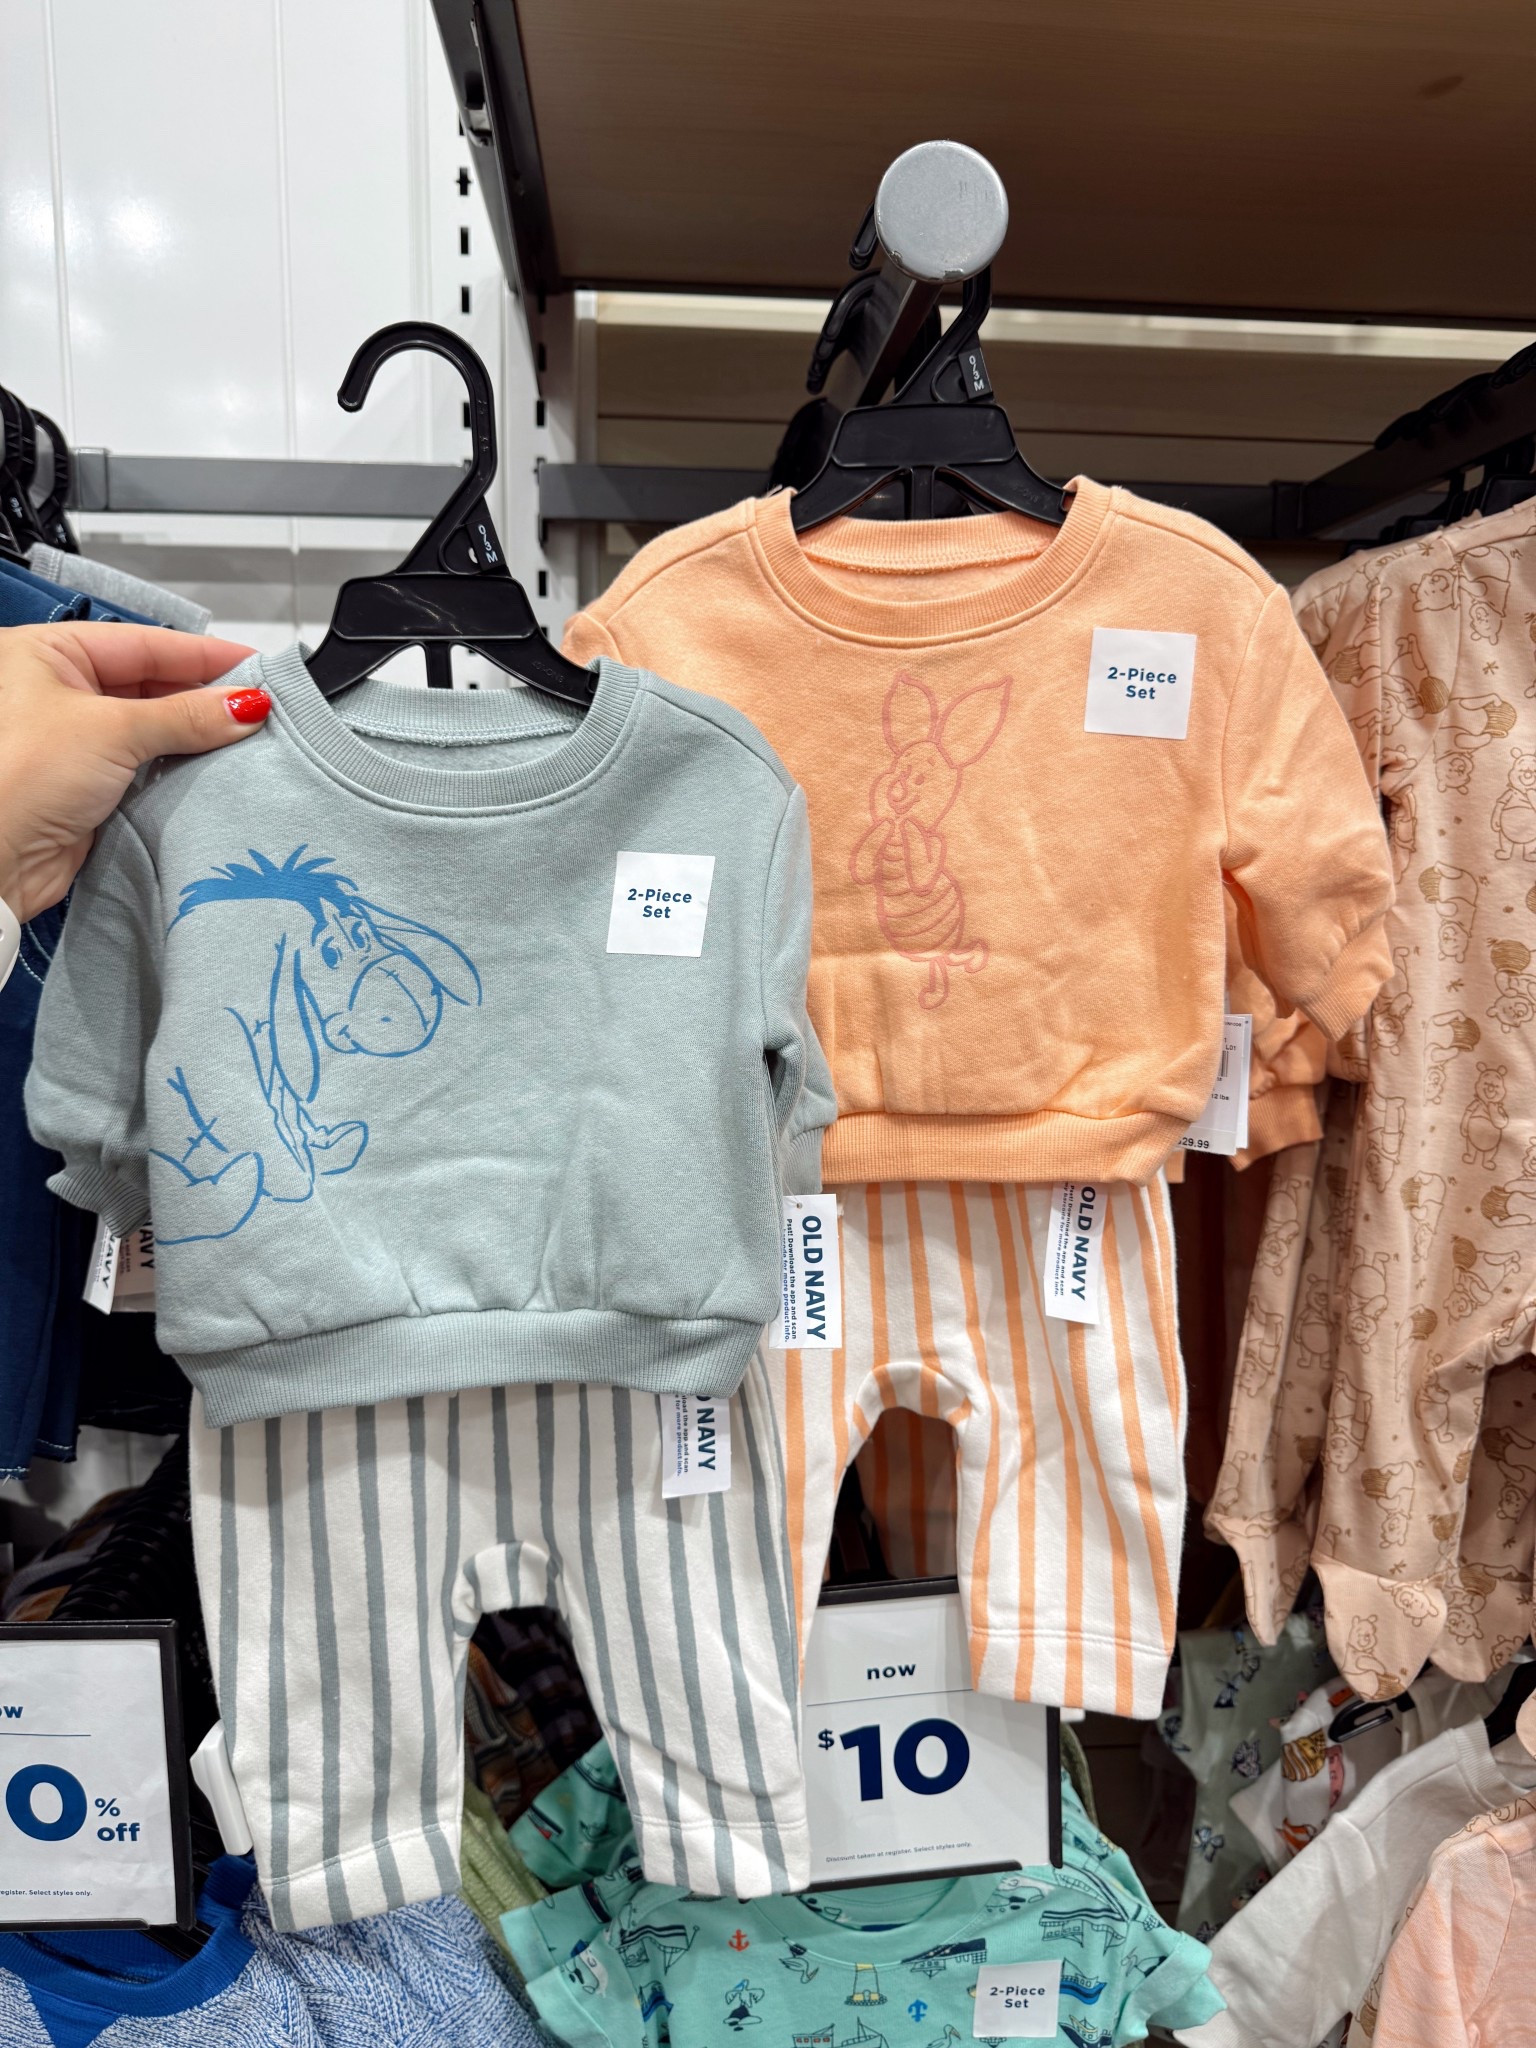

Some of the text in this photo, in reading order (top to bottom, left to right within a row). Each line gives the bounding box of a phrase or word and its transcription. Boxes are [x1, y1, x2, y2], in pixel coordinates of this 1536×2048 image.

[1107, 666, 1177, 684] 2-Piece
[1125, 685, 1156, 700] Set
[627, 888, 692, 903] 2-Piece
[642, 905, 671, 918] Set
[1219, 1093, 1229, 1101] lbs
[1178, 1136, 1210, 1149] 29.99
[1071, 1186, 1096, 1301] OLD NAVY
[787, 1238, 796, 1274] Download
[802, 1215, 826, 1340] OLD NAVY
[782, 1293, 790, 1323] product
[696, 1407, 716, 1471] NAVY
[867, 1664, 916, 1680] now
[0, 1705, 24, 1719] w
[97, 1822, 141, 1842] off
[826, 1853, 856, 1863] Discount
[914, 1845, 935, 1853] Select
[936, 1844, 955, 1852] styles
[989, 1986, 1046, 1996] 2-Piece
[1004, 1998, 1029, 2008] Set
